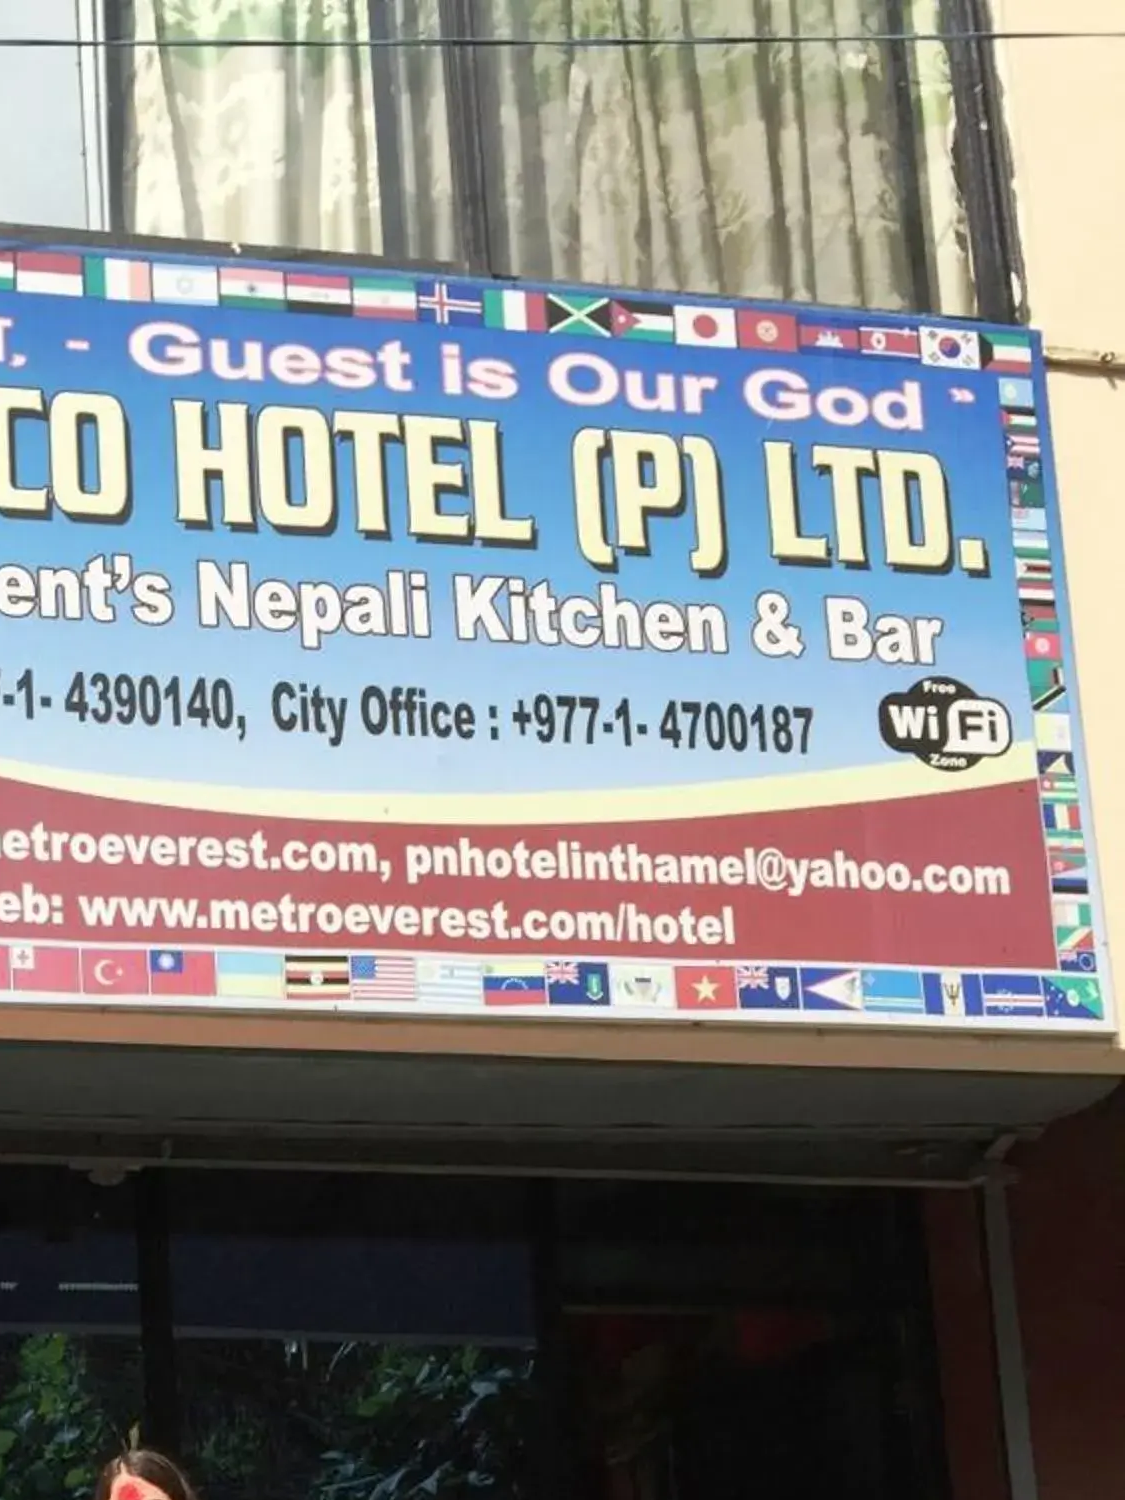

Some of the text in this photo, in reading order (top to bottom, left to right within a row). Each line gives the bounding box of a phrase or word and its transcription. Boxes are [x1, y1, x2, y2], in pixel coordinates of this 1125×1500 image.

[130, 321, 412, 390] Guest
[442, 344, 519, 398] is
[548, 354, 717, 414] Our
[745, 368, 924, 431] God
[171, 398, 537, 546] HOTEL
[572, 426, 728, 575] (P)
[763, 440, 989, 578] LTD.
[197, 559, 429, 649] Nepali
[455, 580, 729, 653] Kitchen
[751, 591, 804, 659] &
[824, 595, 944, 666] Bar
[64, 671, 245, 740] 4390140,
[271, 680, 347, 745] City
[511, 698, 649, 750] +977-1-
[660, 700, 814, 755] 4700187
[923, 680, 956, 694] Free
[930, 753, 967, 768] Zone
[405, 838, 1011, 897] pnhotelinthamel@yahoo.com
[79, 894, 737, 948] www.metroeverest.com/hotel
